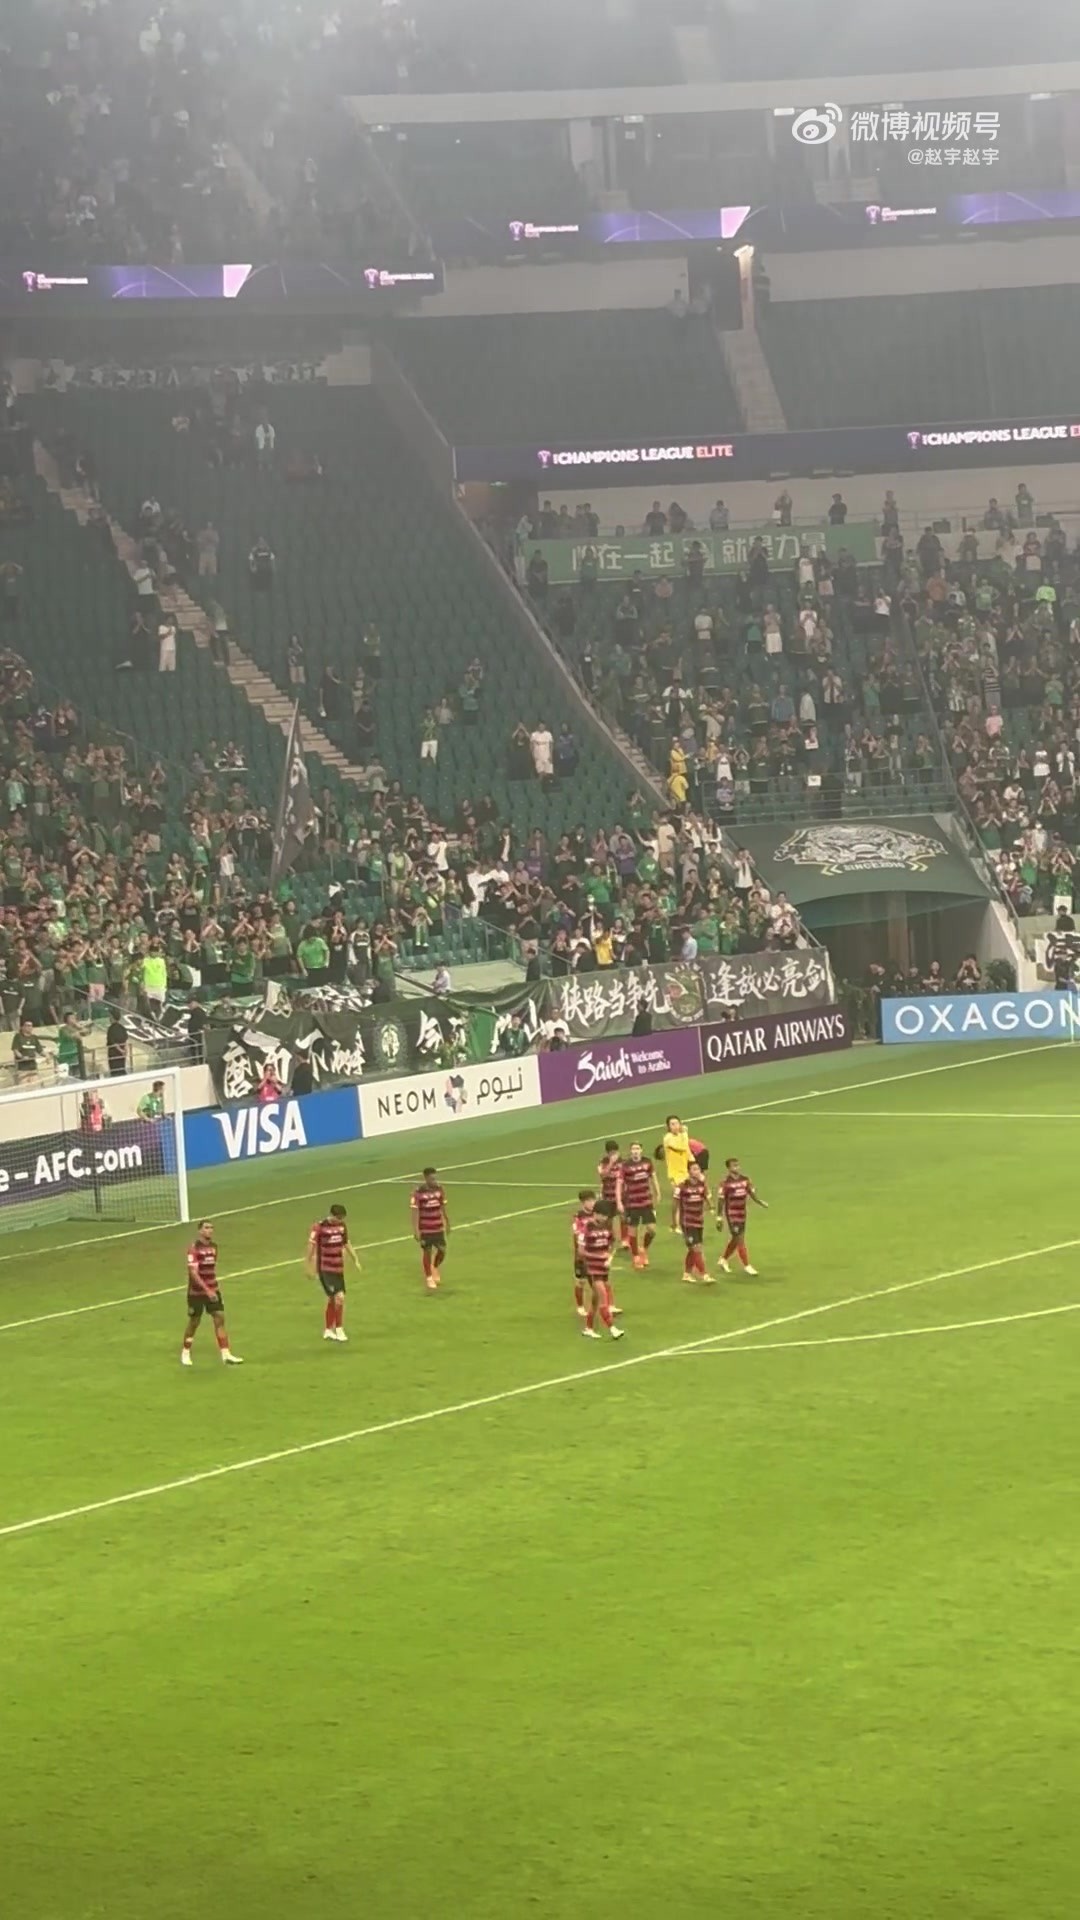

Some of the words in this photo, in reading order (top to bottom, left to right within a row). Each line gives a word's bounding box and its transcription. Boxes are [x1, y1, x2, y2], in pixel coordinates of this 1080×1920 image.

[557, 449, 640, 465] CHAMPIONS
[641, 446, 694, 461] LEAGUE
[695, 444, 733, 458] ELITE
[927, 429, 1011, 446] CHAMPIONS
[1012, 425, 1068, 441] LEAGUE
[560, 970, 673, 1029] 狭路当争先
[706, 957, 826, 1007] 逢敌必亮剑
[894, 998, 1080, 1036] OXAGON
[631, 1050, 664, 1063] Welcome
[706, 1027, 766, 1063] QATAR
[773, 1013, 846, 1049] AIRWAYS
[476, 1066, 524, 1105] نيوم
[574, 1047, 633, 1093] Saudi
[377, 1087, 437, 1119] NEOM
[212, 1100, 308, 1159] VISA
